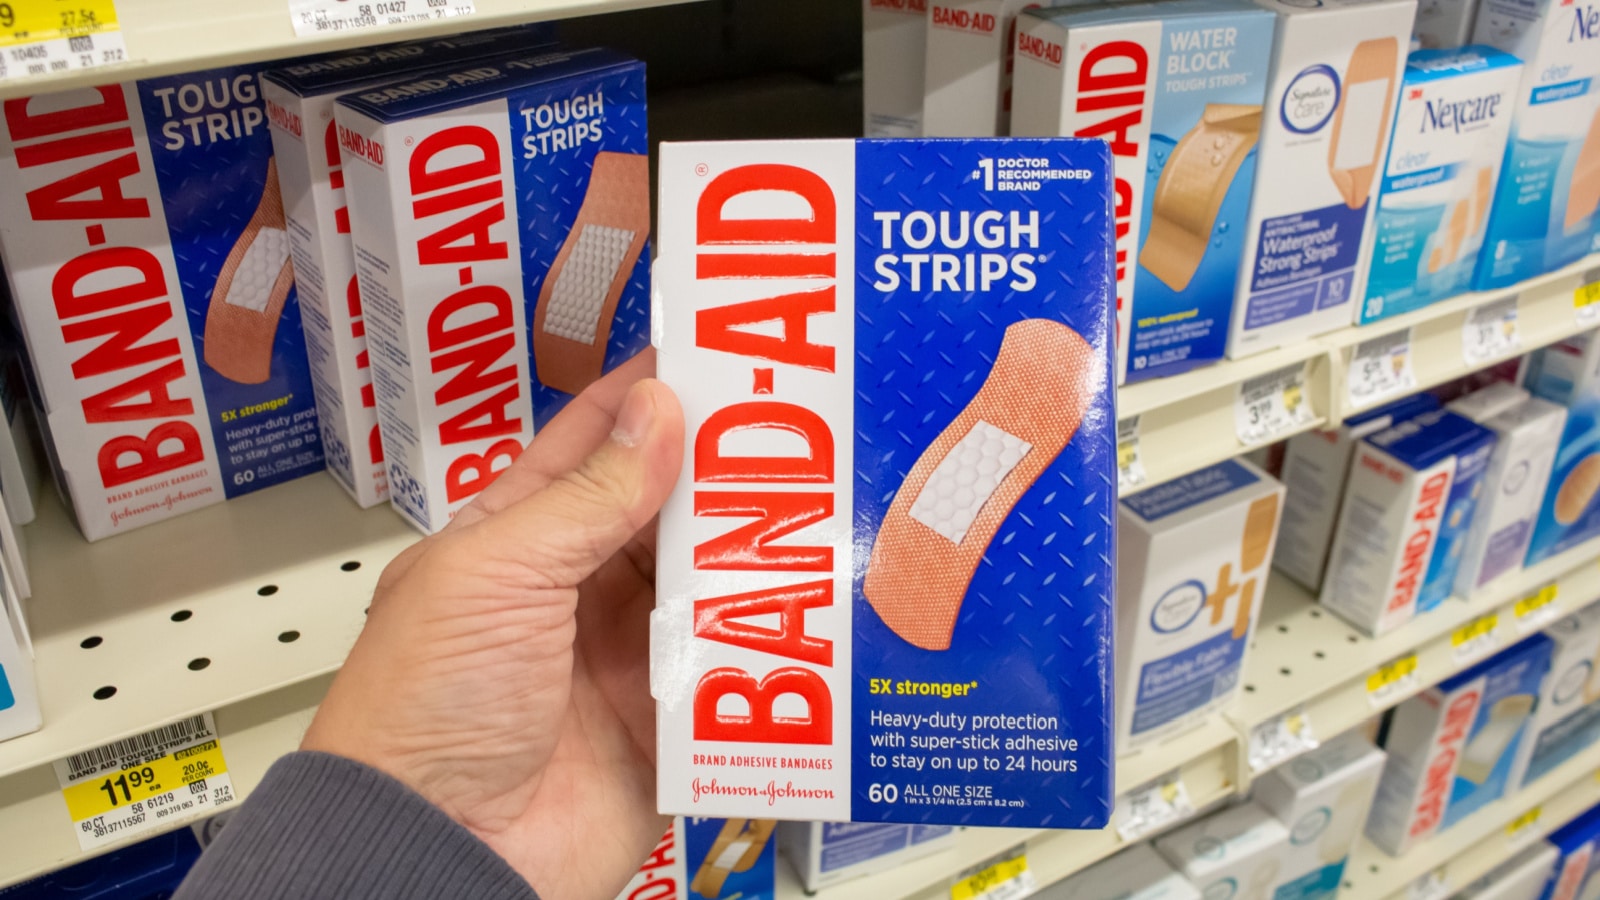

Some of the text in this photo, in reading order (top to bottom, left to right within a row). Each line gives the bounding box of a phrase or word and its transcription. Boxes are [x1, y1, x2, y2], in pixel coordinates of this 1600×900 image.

[359, 1, 406, 17] 58 01427
[933, 6, 995, 32] BAND-AID
[1018, 31, 1062, 64] BAND-AID
[1170, 27, 1237, 51] WATER
[1166, 50, 1231, 76] BLOCK
[1541, 63, 1573, 83] clear
[153, 73, 262, 118] TOUG
[360, 66, 500, 104] BAND-AID
[1165, 77, 1206, 93] TOUGH
[520, 91, 604, 132] TOUGH
[1420, 92, 1501, 134] Nexcare
[162, 106, 268, 151] STRIP
[338, 124, 384, 165] BAND-AID
[1396, 151, 1430, 171] clear
[972, 158, 1050, 191] #1 DOCTOR
[997, 169, 1092, 180] RECOMMENDED
[1391, 166, 1445, 190] waterproof
[997, 181, 1042, 192] BRAND
[873, 209, 1040, 250] TOUGH
[1263, 222, 1338, 255] Waterproof
[1258, 253, 1303, 275] Strong
[408, 125, 525, 504] BAND-AID
[1365, 296, 1384, 318] 20
[1134, 355, 1147, 370] 10
[221, 409, 238, 423] 5X
[225, 407, 316, 441] Heavy-duty prot
[228, 420, 315, 454] with super-stick
[231, 433, 317, 465] to stay on up to
[233, 468, 255, 485] 60
[1388, 470, 1449, 613] BAND-AID
[869, 678, 892, 694] 5X
[870, 710, 1058, 731] Heavy-duty protection
[870, 732, 1079, 752] with super-stick adhesive
[68, 729, 213, 782] BAND AID TOUGH STRIPS ALL
[121, 751, 168, 772] ONE SIZE
[693, 754, 833, 770] BRAND ADHESIVE BANDAGES
[870, 753, 1078, 773] to stay on up to 24 hours
[182, 760, 209, 776] 20.0¢
[182, 767, 214, 784] PER COUNT
[149, 783, 162, 792] ea
[868, 782, 993, 803] 60 ALL ONE SIZE
[93, 813, 147, 838] 38137115567
[156, 809, 165, 818] 009
[169, 805, 181, 815] 319
[197, 793, 208, 804] 21
[214, 785, 230, 799] 312
[131, 792, 175, 815] 58 61219
[81, 816, 105, 833] 60 CT
